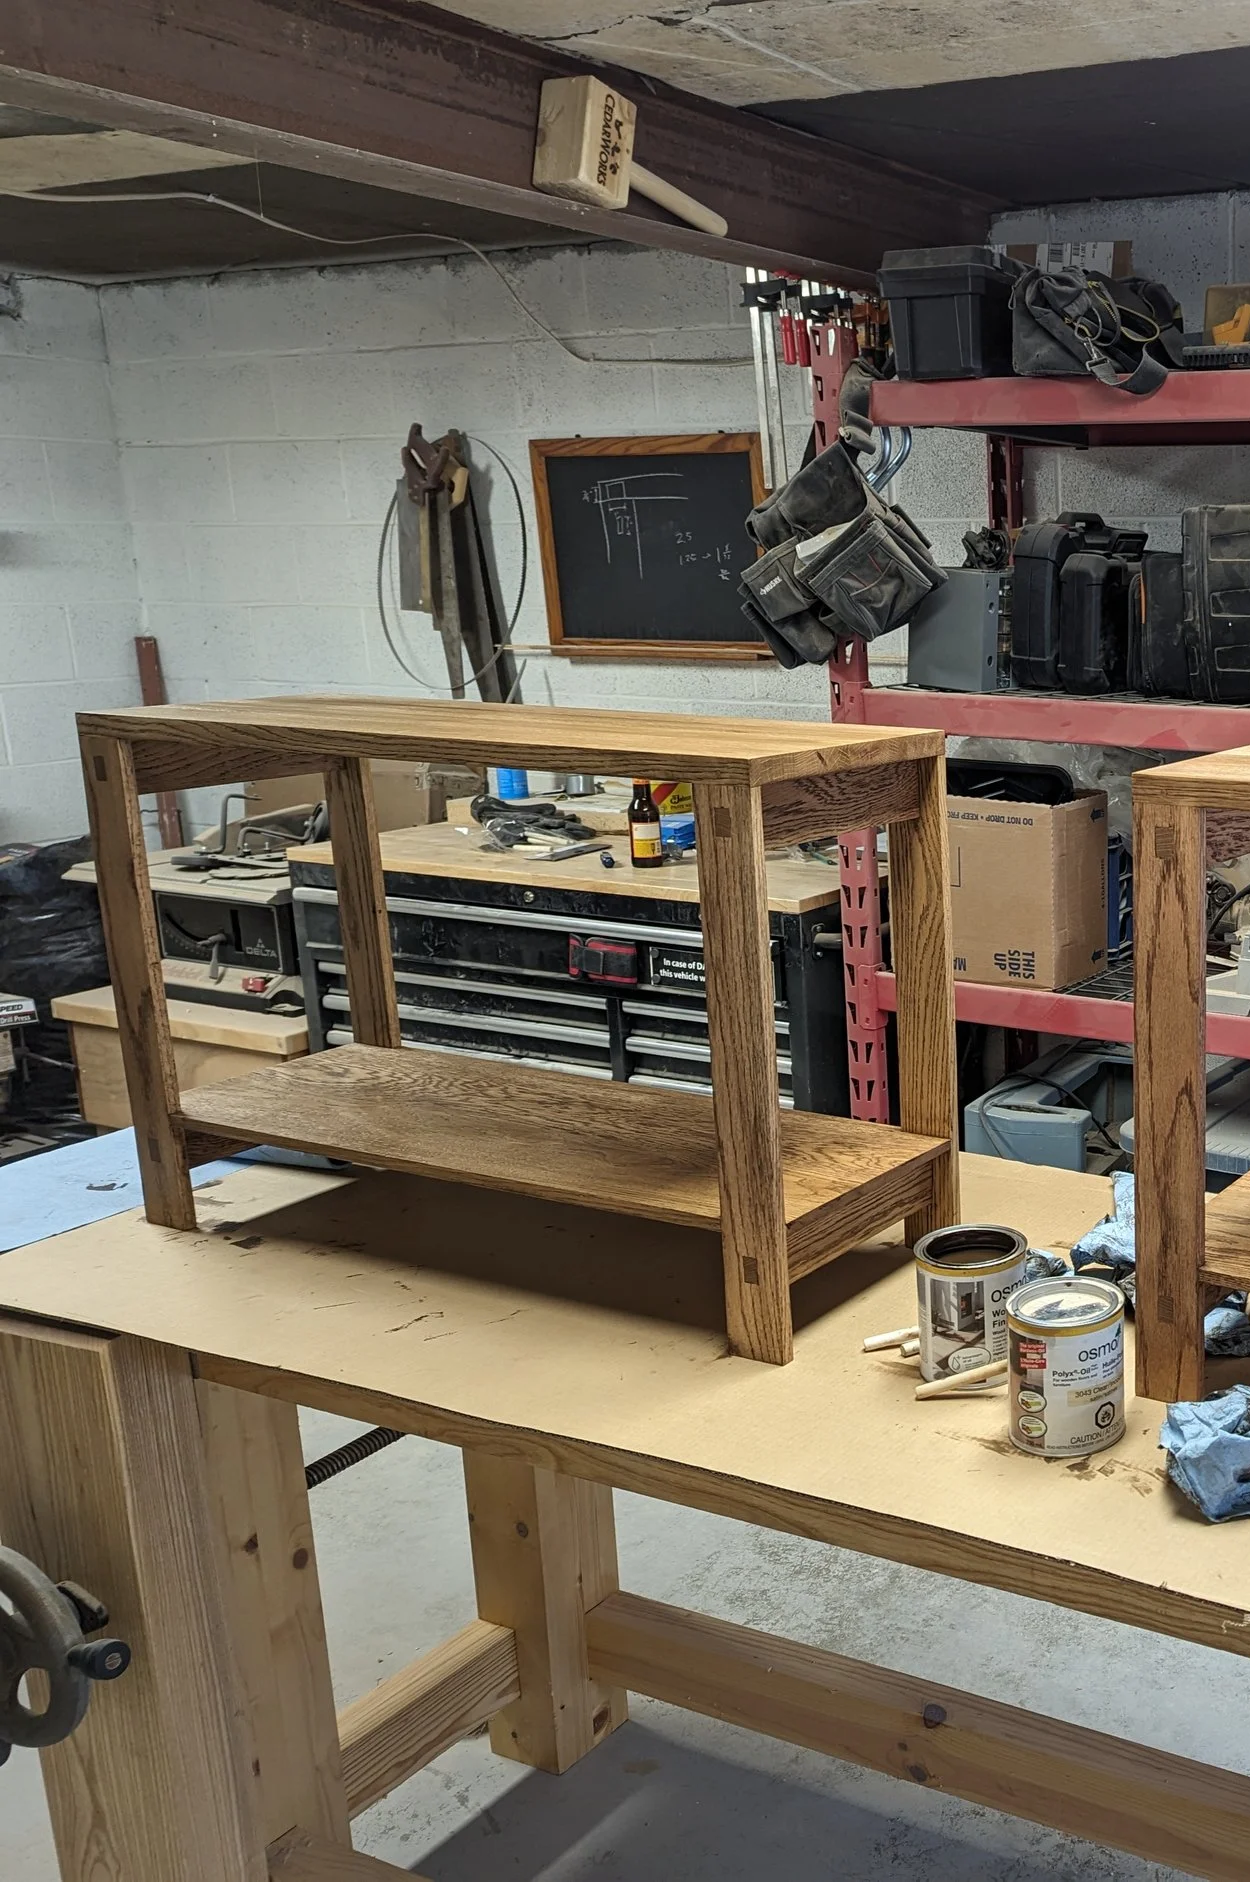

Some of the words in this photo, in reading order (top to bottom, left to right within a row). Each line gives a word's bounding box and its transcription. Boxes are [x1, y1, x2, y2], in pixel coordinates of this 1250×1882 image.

[597, 94, 615, 187] CEDARWORKS
[765, 575, 783, 593] HUSKY
[960, 812, 979, 821] KEEP
[985, 814, 1005, 824] DROP
[1006, 816, 1021, 825] NOT
[1022, 818, 1034, 826] DO
[245, 946, 277, 958] DELTA
[663, 957, 671, 966] In
[671, 960, 687, 969] case
[687, 961, 696, 970] of
[696, 962, 705, 971] D
[994, 952, 1007, 971] UP
[1008, 949, 1021, 978] SIDE
[1022, 951, 1035, 980] THIS
[659, 968, 673, 978] this
[673, 971, 699, 982] vehicle
[14, 1014, 31, 1023] Press
[1078, 1338, 1118, 1362] osmo
[1075, 1389, 1092, 1398] 3043
[1070, 1432, 1102, 1445] CAUTION
